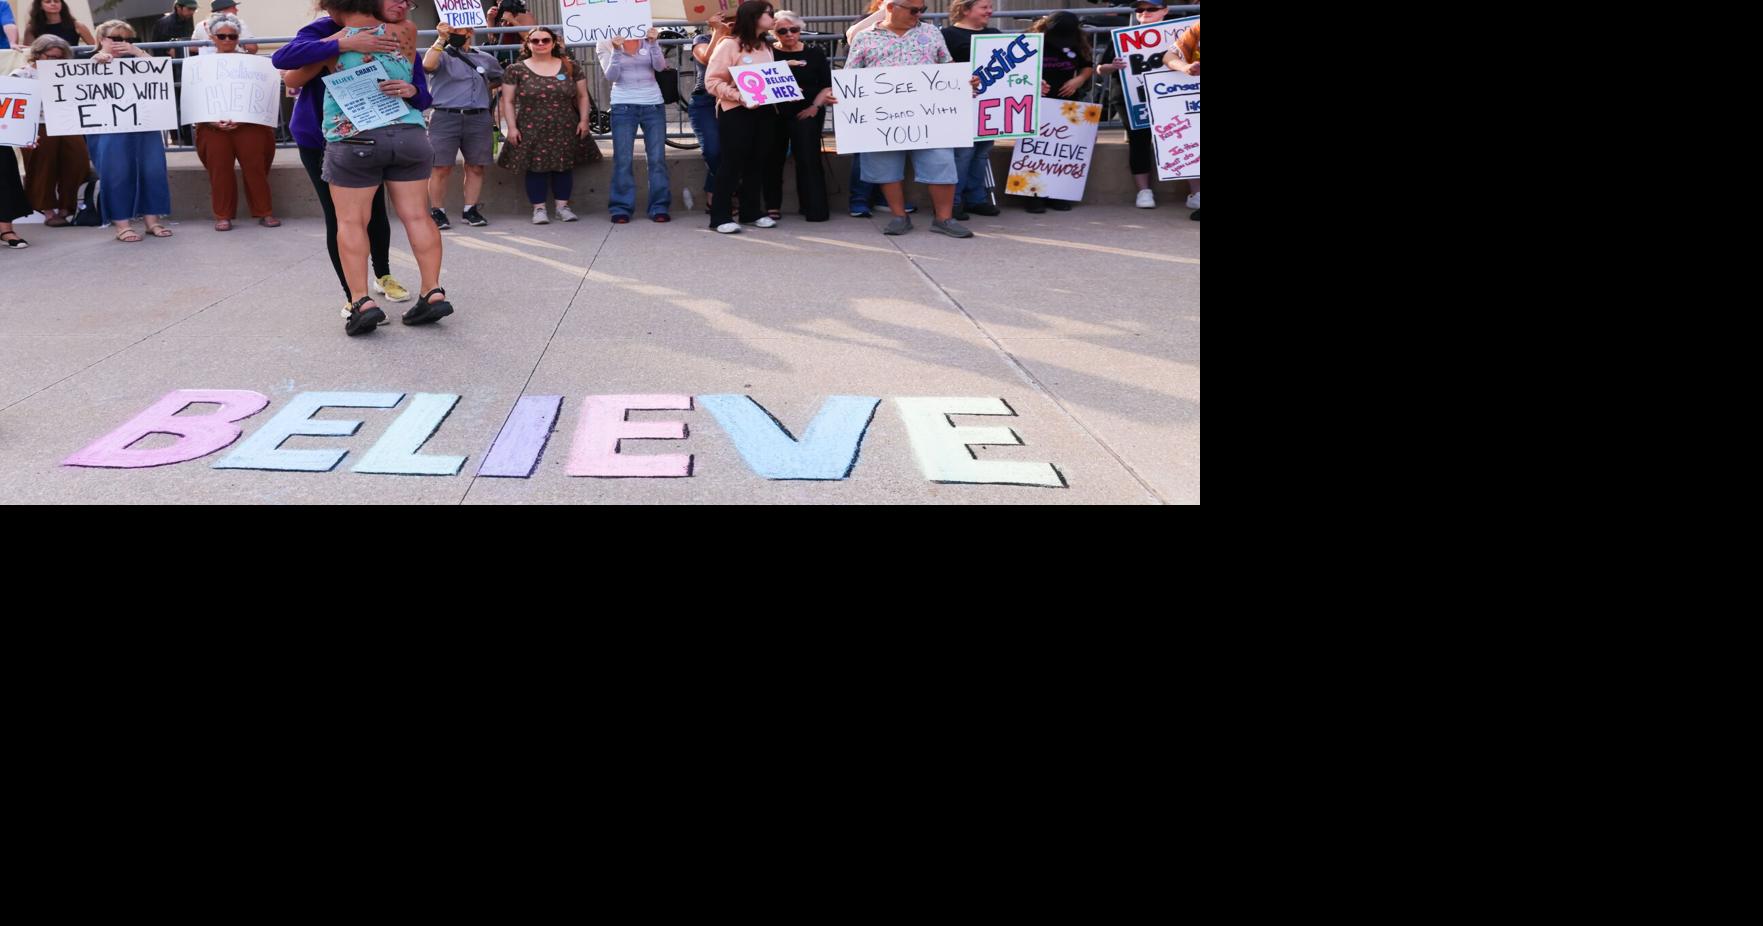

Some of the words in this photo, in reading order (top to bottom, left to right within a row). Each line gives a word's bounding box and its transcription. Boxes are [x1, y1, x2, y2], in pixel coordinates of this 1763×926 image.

[444, 12, 483, 26] TRUTHS
[565, 14, 647, 43] Survivors
[1119, 29, 1161, 52] NO
[55, 60, 114, 78] JUSTICE
[120, 59, 168, 76] NOW
[761, 68, 779, 76] WE
[765, 75, 796, 85] BELIEVE
[874, 72, 917, 94] SEE
[53, 84, 66, 102] I
[75, 83, 125, 100] STAND
[133, 82, 169, 100] WITH
[771, 85, 799, 98] HER
[78, 103, 141, 128] E.M.
[977, 95, 1035, 136] E.M.
[877, 125, 929, 146] YOU!
[1021, 138, 1087, 161] BELIEVE
[58, 388, 1069, 488] BELIEVE
